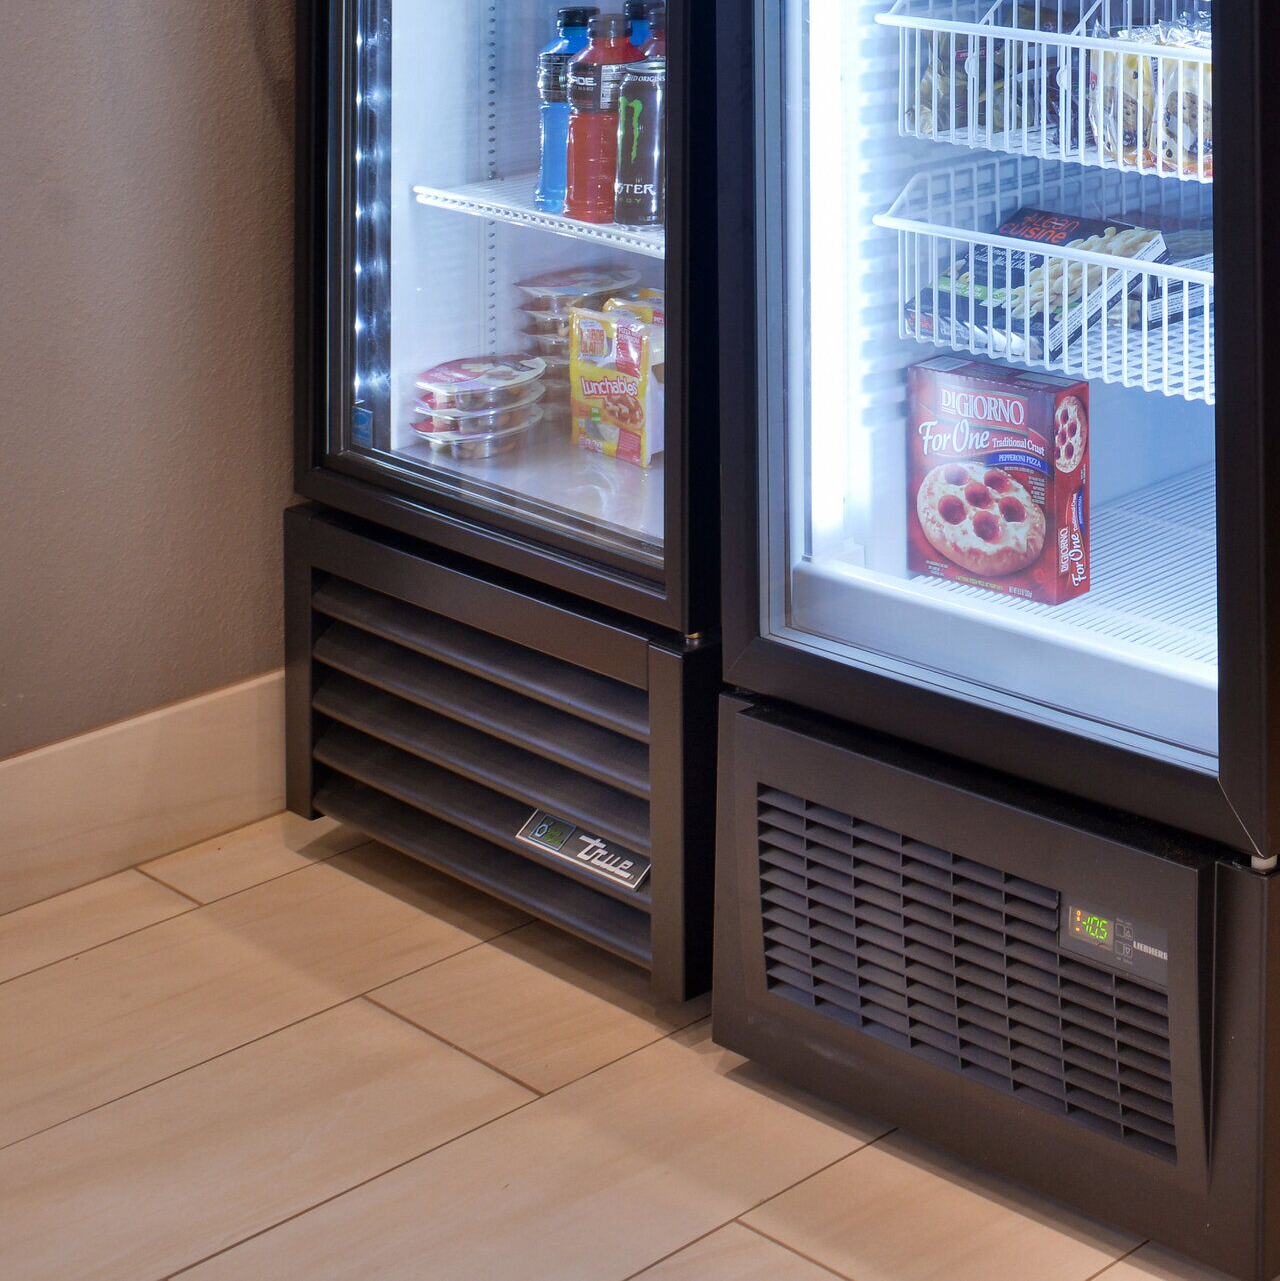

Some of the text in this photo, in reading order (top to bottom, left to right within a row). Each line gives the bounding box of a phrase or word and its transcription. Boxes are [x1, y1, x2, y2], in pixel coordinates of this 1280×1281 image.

[580, 375, 639, 398] Lunchables
[918, 417, 990, 456] For One
[991, 437, 1046, 457] Traditional Crust
[998, 453, 1043, 468] PEPPERONI PIZZA
[577, 834, 634, 883] true
